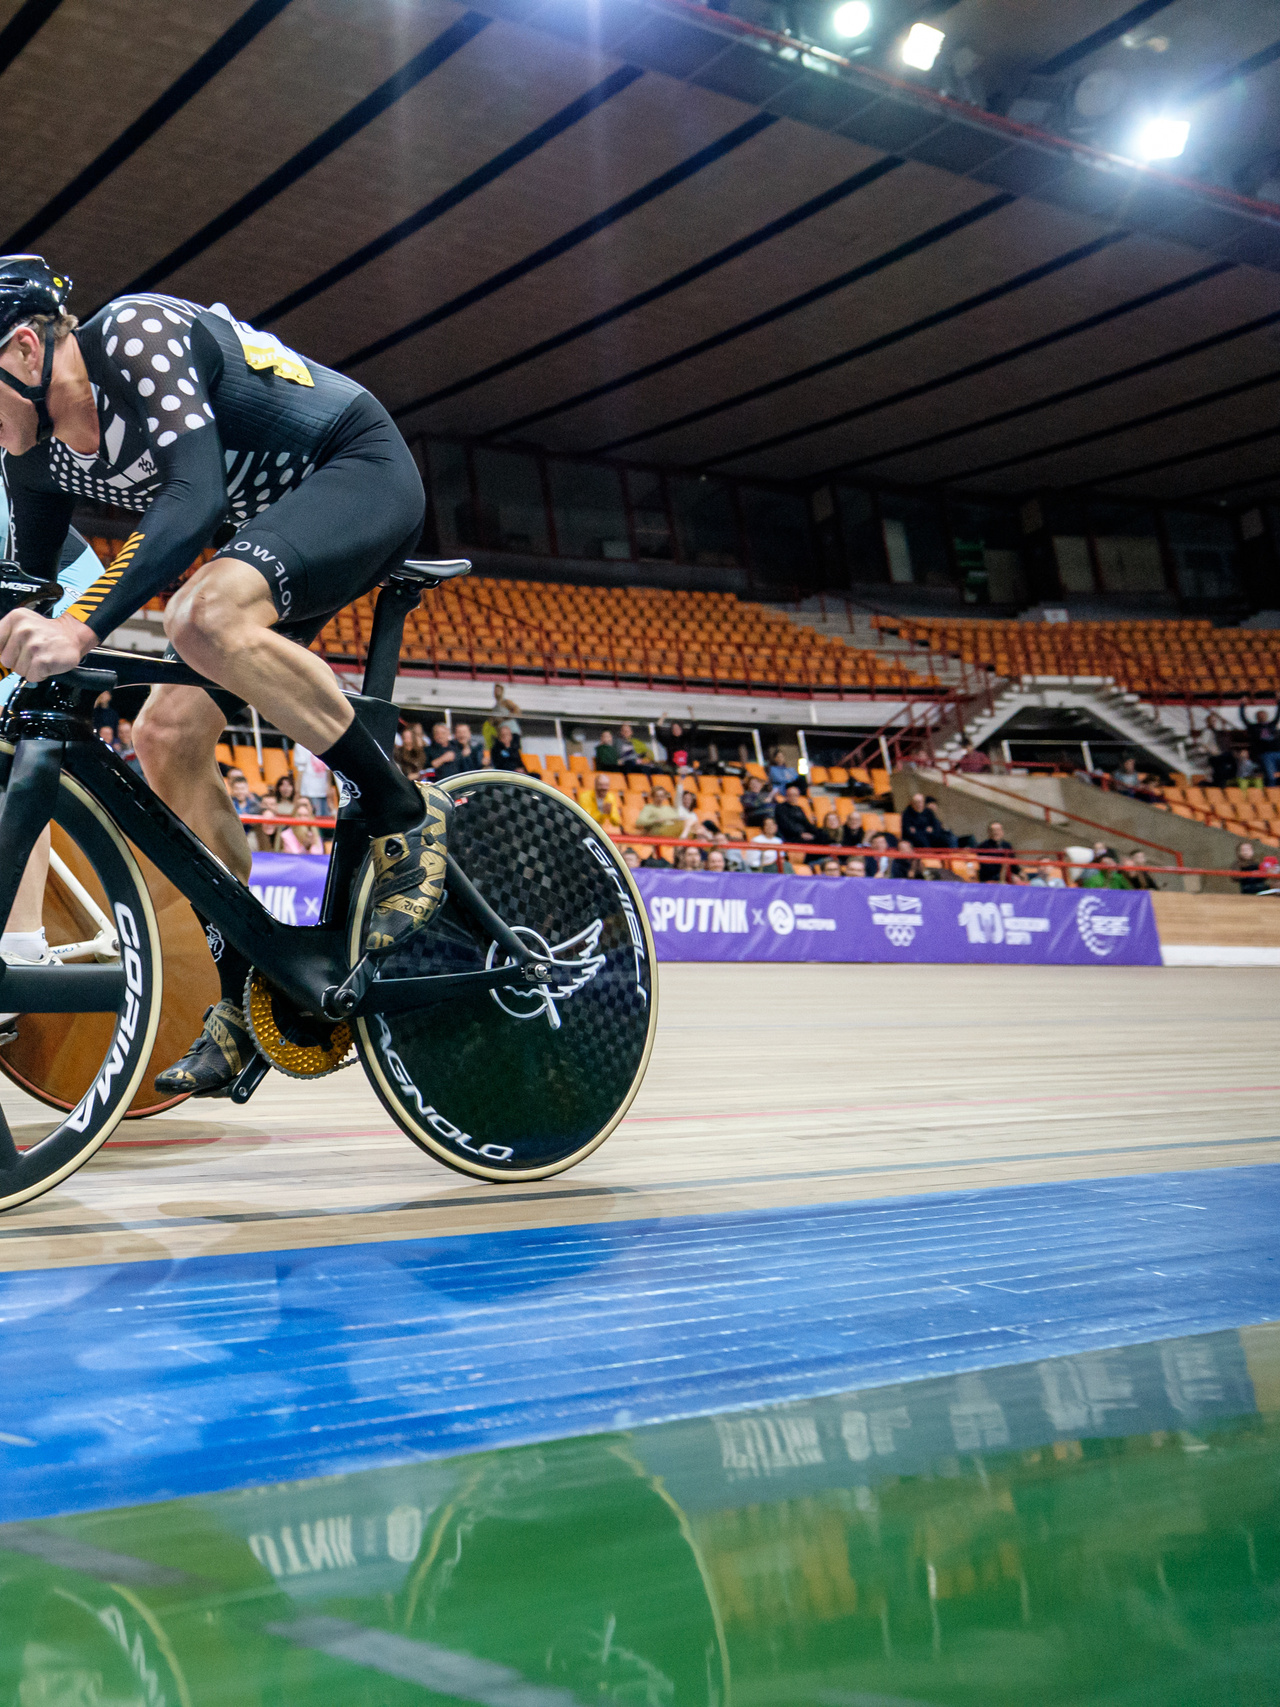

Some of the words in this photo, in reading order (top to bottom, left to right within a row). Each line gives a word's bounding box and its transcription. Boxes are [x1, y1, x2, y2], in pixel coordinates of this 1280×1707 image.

[650, 896, 749, 933] SPUTNIK
[65, 902, 143, 1133] CORIMA
[375, 1012, 514, 1161] AGNOLO
